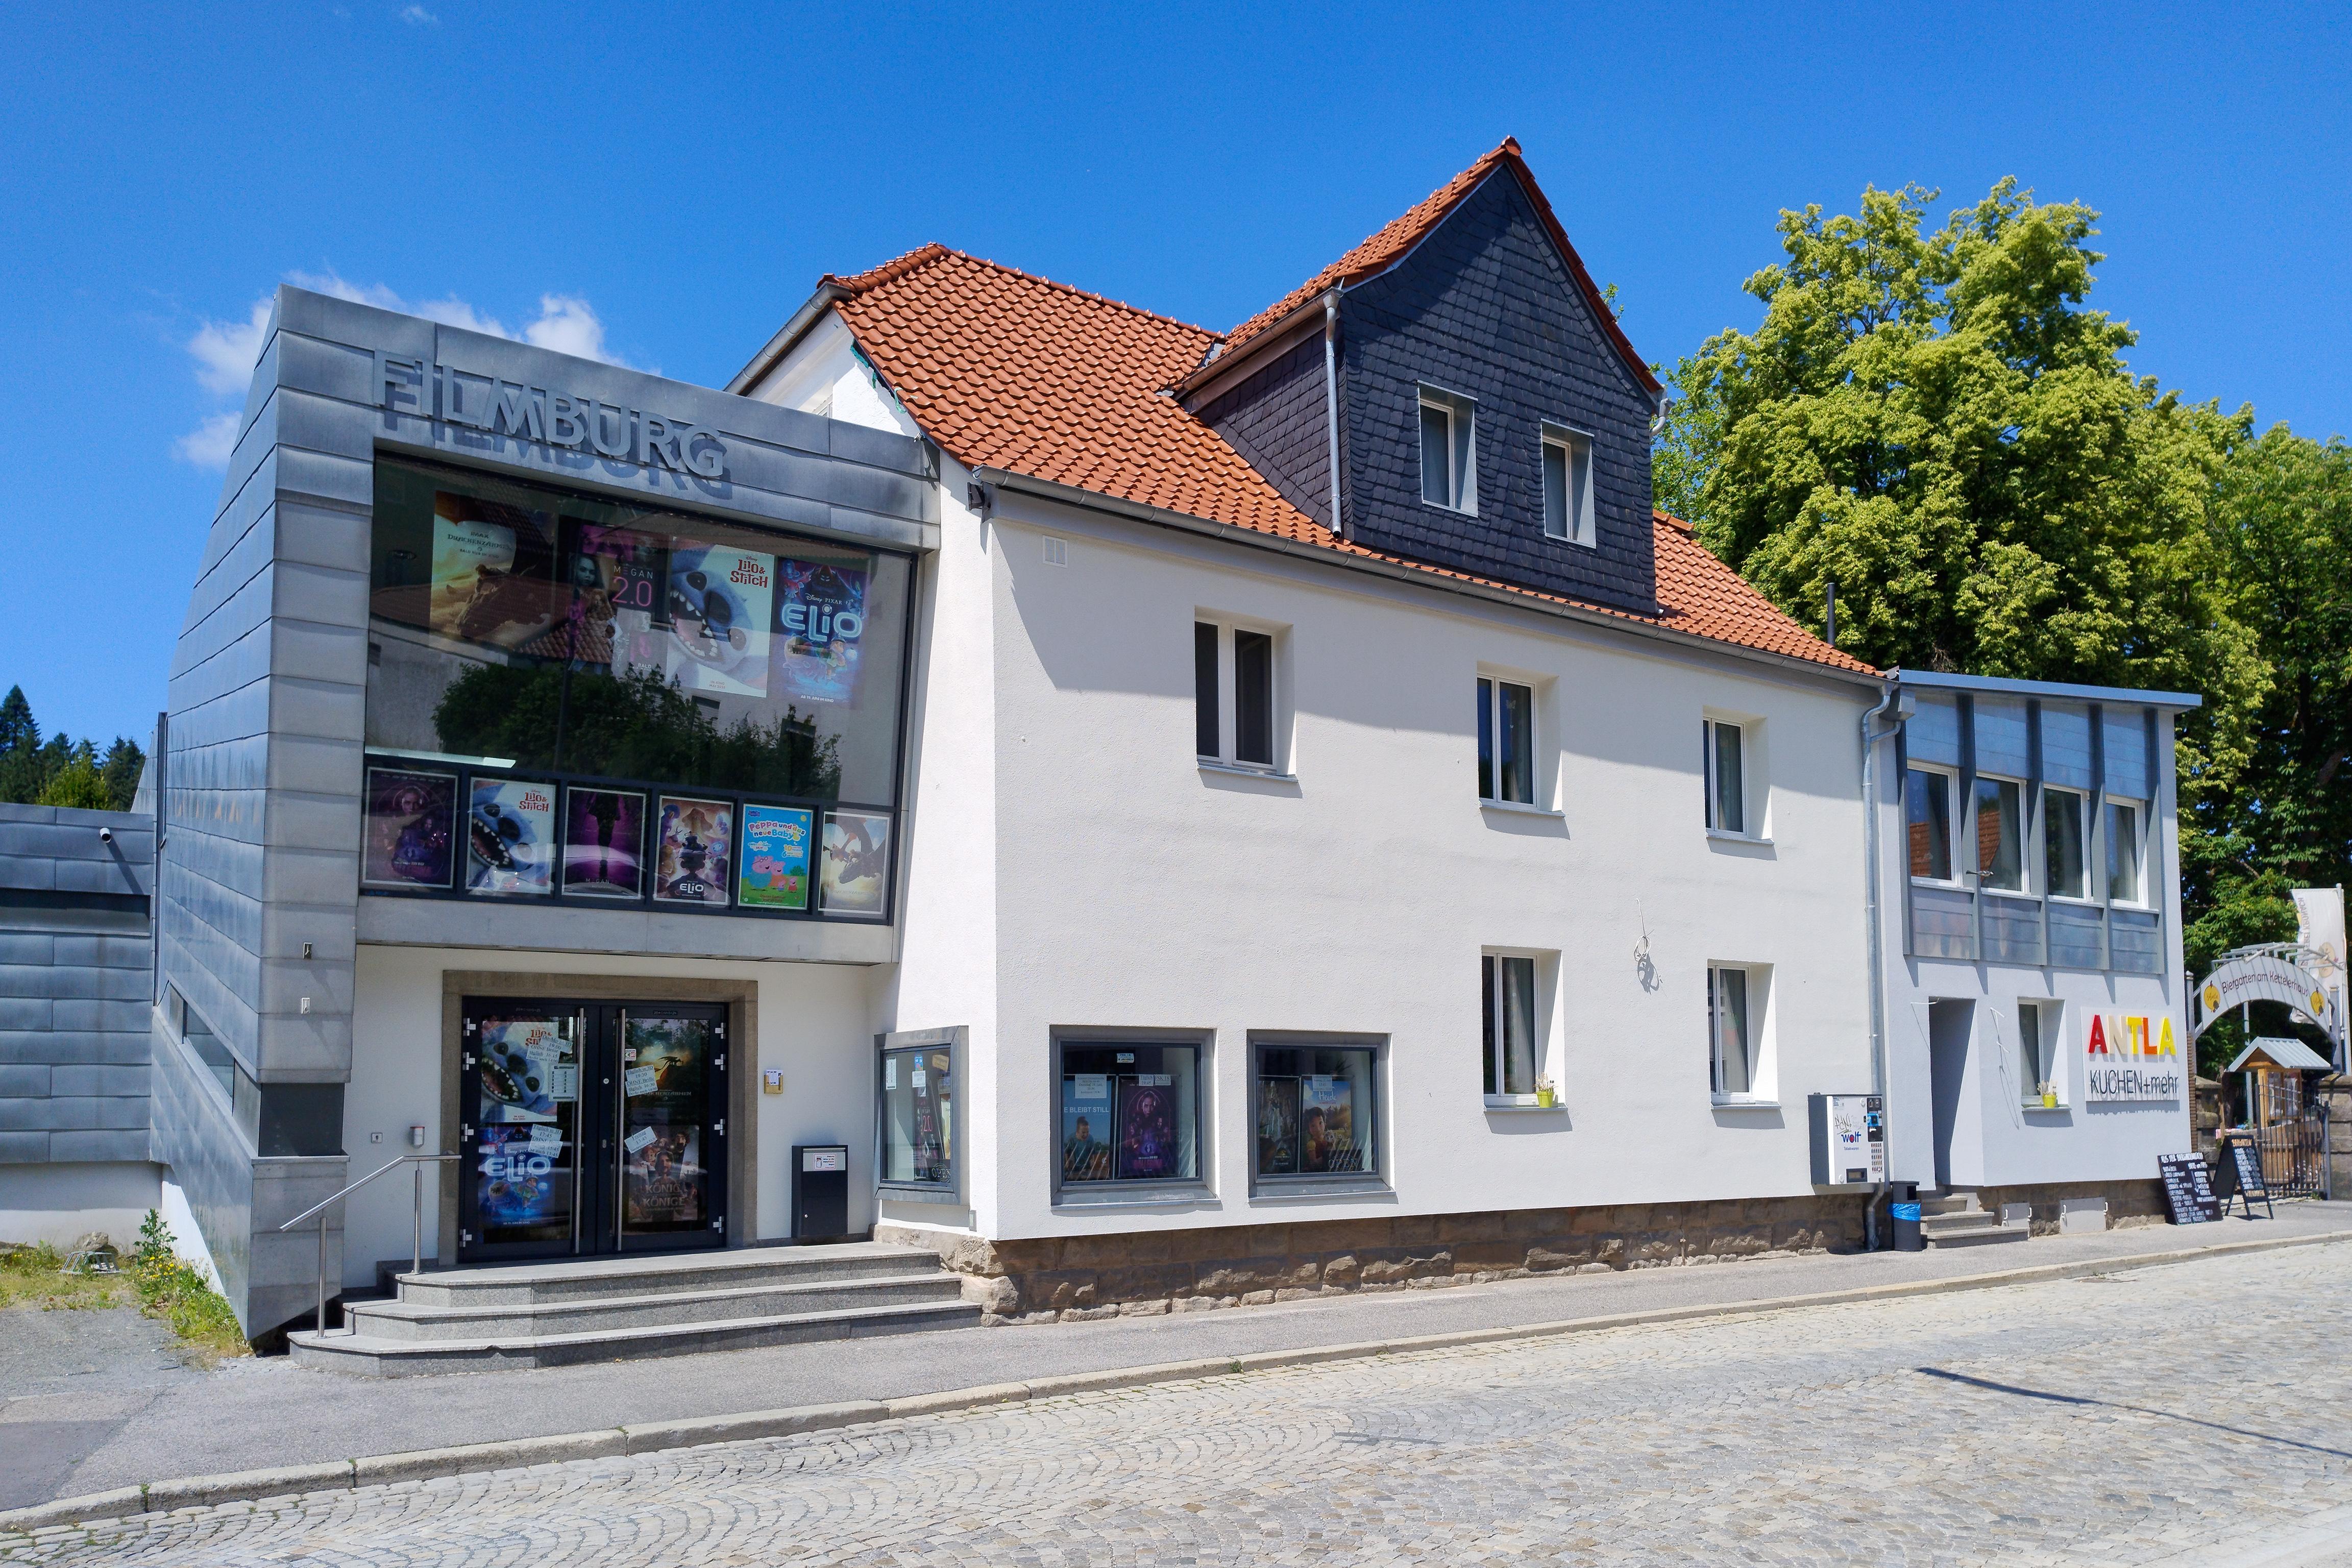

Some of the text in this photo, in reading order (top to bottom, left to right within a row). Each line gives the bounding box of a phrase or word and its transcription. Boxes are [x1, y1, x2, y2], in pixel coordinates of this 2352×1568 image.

[374, 350, 724, 477] FILMBURG
[612, 576, 652, 607] 2.0
[749, 821, 778, 831] Peppa
[772, 829, 794, 839] Baby
[2222, 971, 2309, 997] Biergarten am Kettelerhaus
[2088, 1014, 2177, 1056] ANTLA
[2090, 1070, 2178, 1094] KUCHEN+mehr
[1318, 1090, 1336, 1100] Heidi
[1841, 1131, 1861, 1143] wolf
[643, 1195, 686, 1207] KÖNIGE
